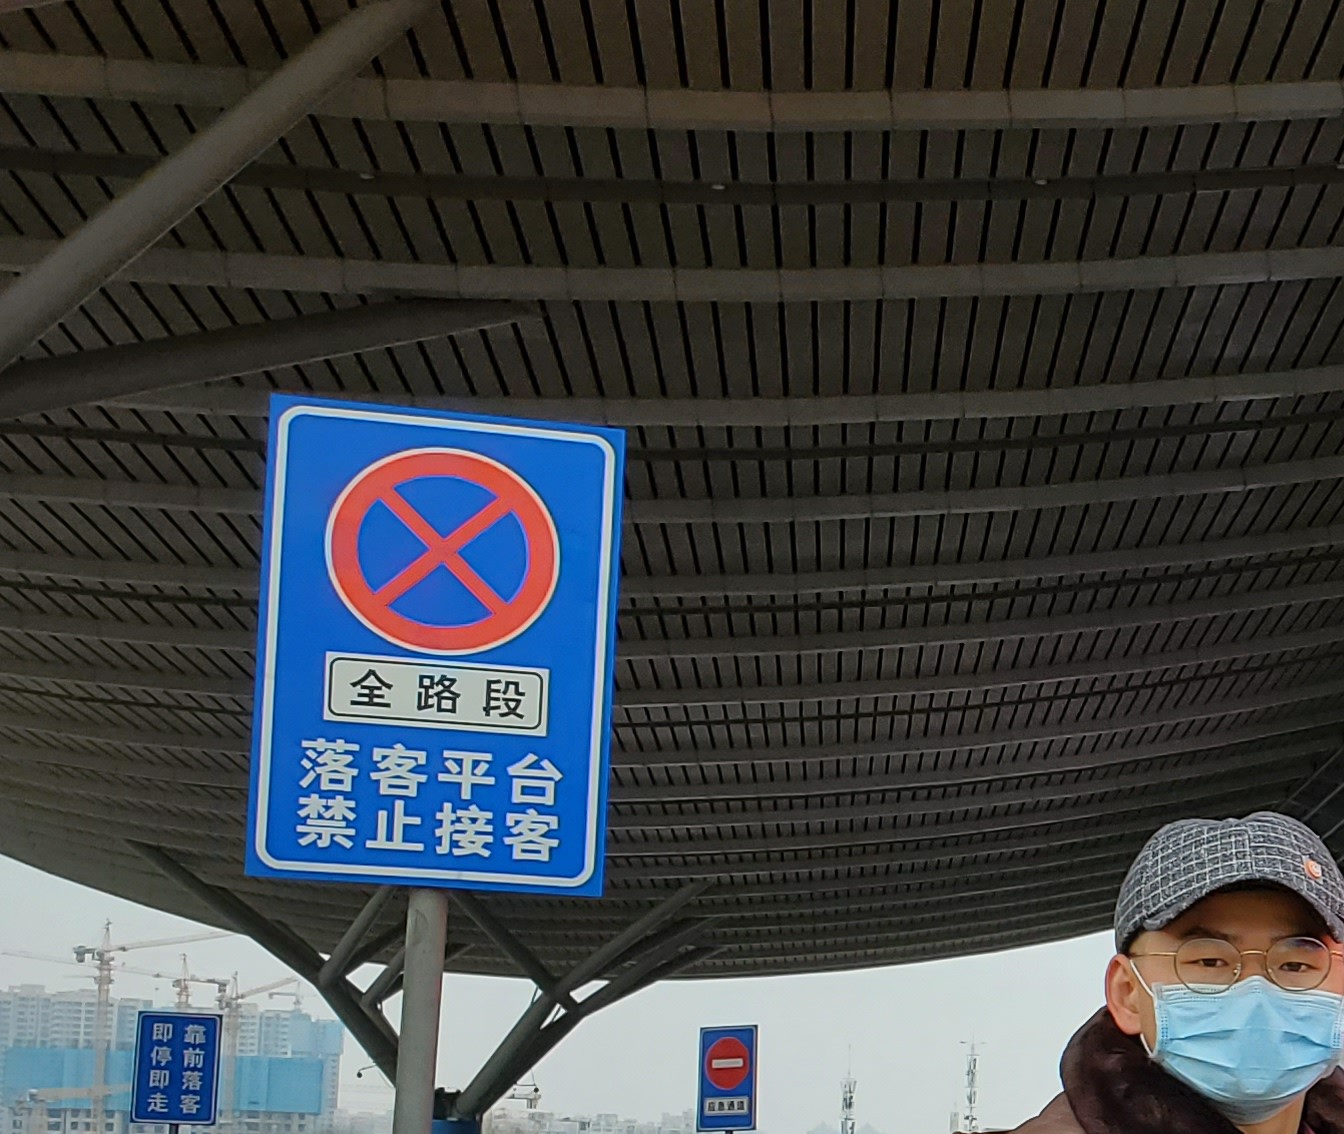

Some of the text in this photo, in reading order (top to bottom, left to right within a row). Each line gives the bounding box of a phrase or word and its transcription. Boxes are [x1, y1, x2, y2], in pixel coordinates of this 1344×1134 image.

[349, 668, 526, 720] 全路段
[299, 737, 564, 807] 落客平台
[296, 792, 560, 863] 禁止接客
[147, 1022, 174, 1113] 即停即走
[179, 1024, 207, 1115] 靠前落客
